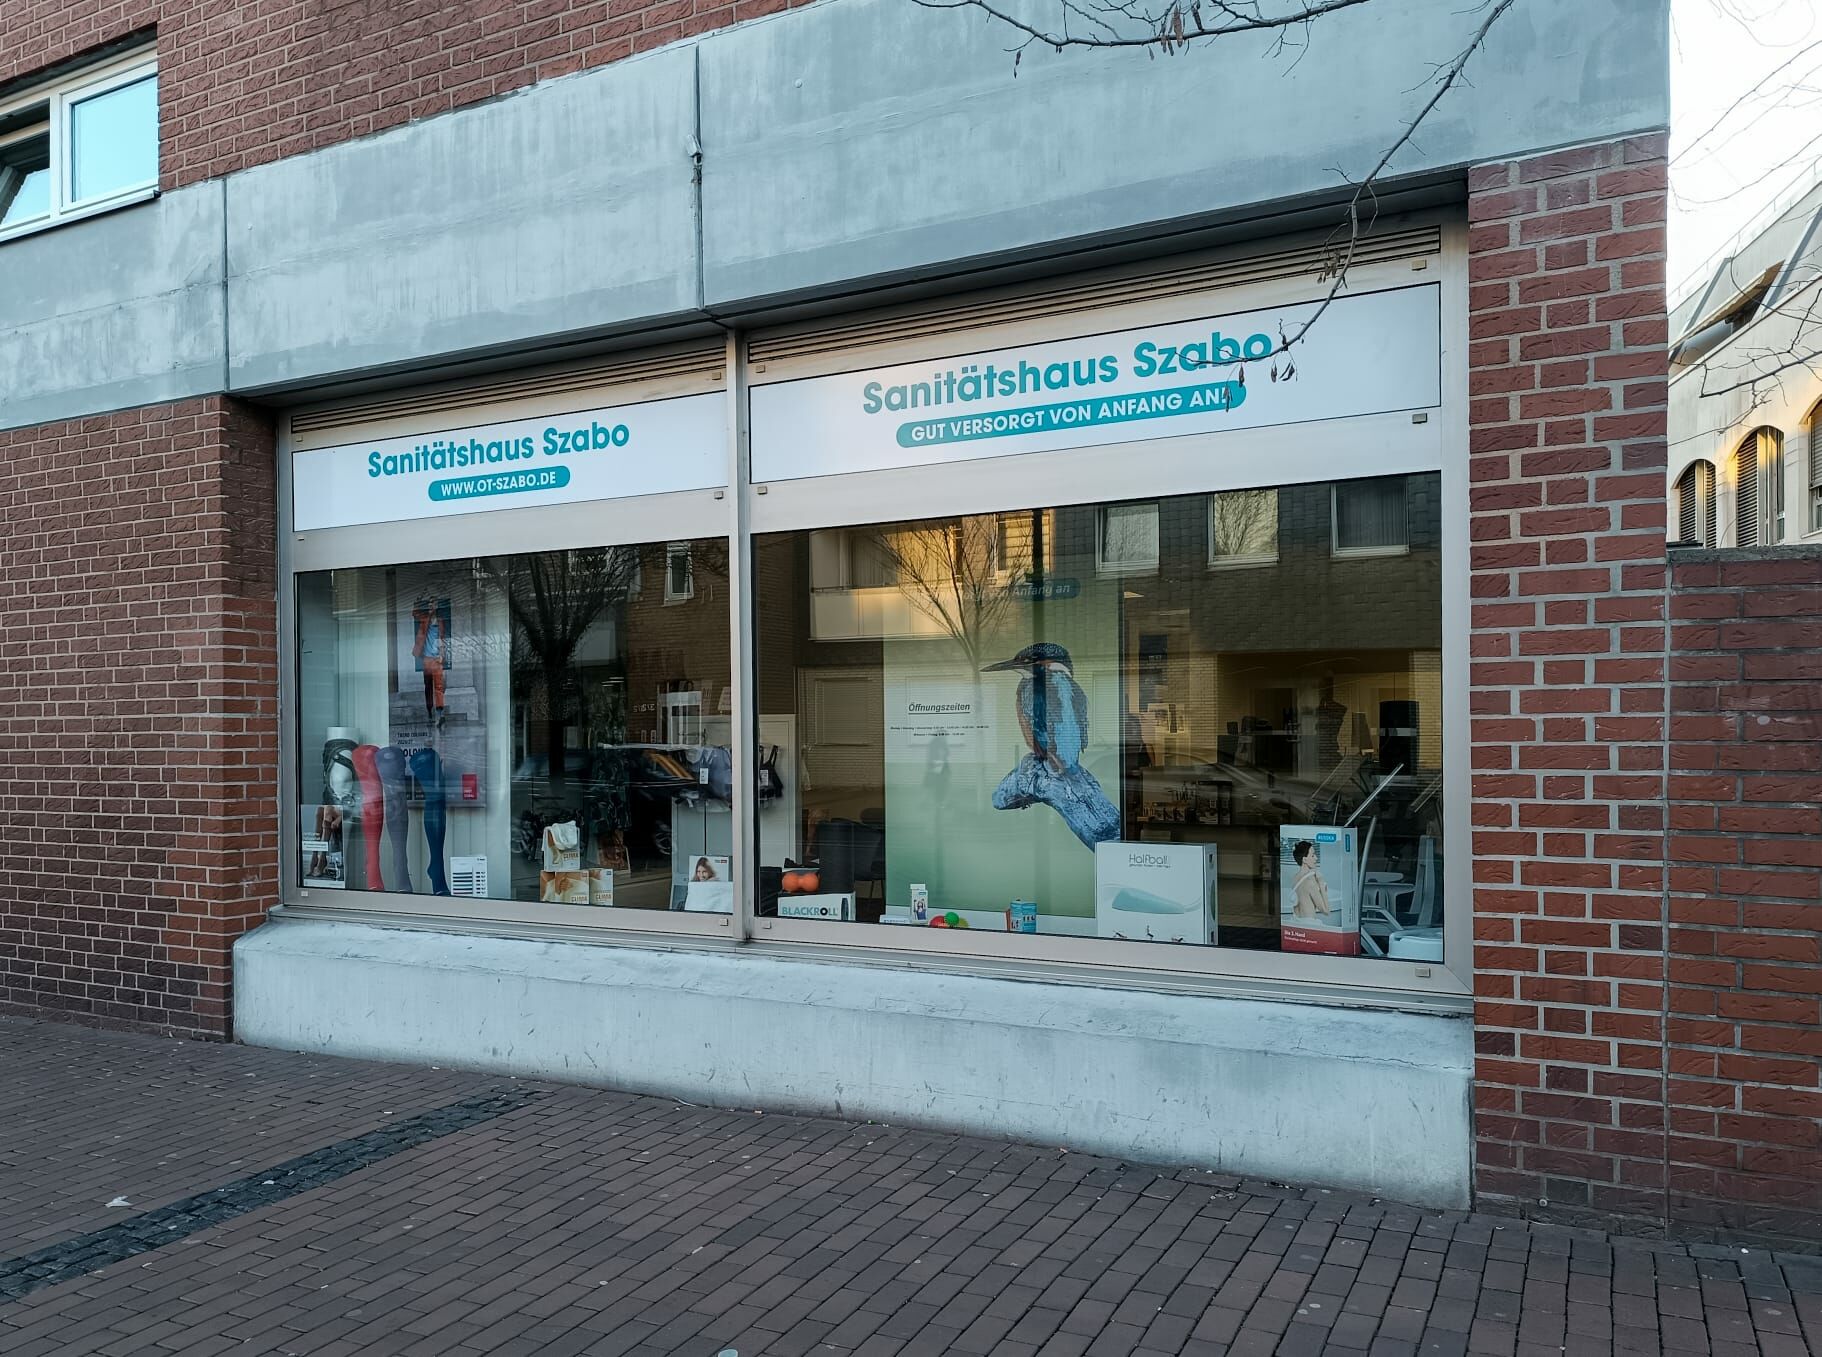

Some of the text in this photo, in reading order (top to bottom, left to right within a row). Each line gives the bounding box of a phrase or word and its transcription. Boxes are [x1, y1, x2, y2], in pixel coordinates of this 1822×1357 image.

[863, 331, 1273, 414] Sanitätshaus Szabo
[911, 423, 946, 442] GUT
[949, 410, 1045, 438] VERSORGT
[1049, 405, 1091, 424] VON
[1097, 392, 1182, 419] ANFANG
[368, 421, 630, 478] Sanitätshaus Szabo
[440, 471, 556, 497] WWW.OT-SZABO.DE
[1055, 584, 1070, 594] an
[908, 702, 971, 713] Öffnungszeiten
[782, 906, 838, 917] BLACKROLL
